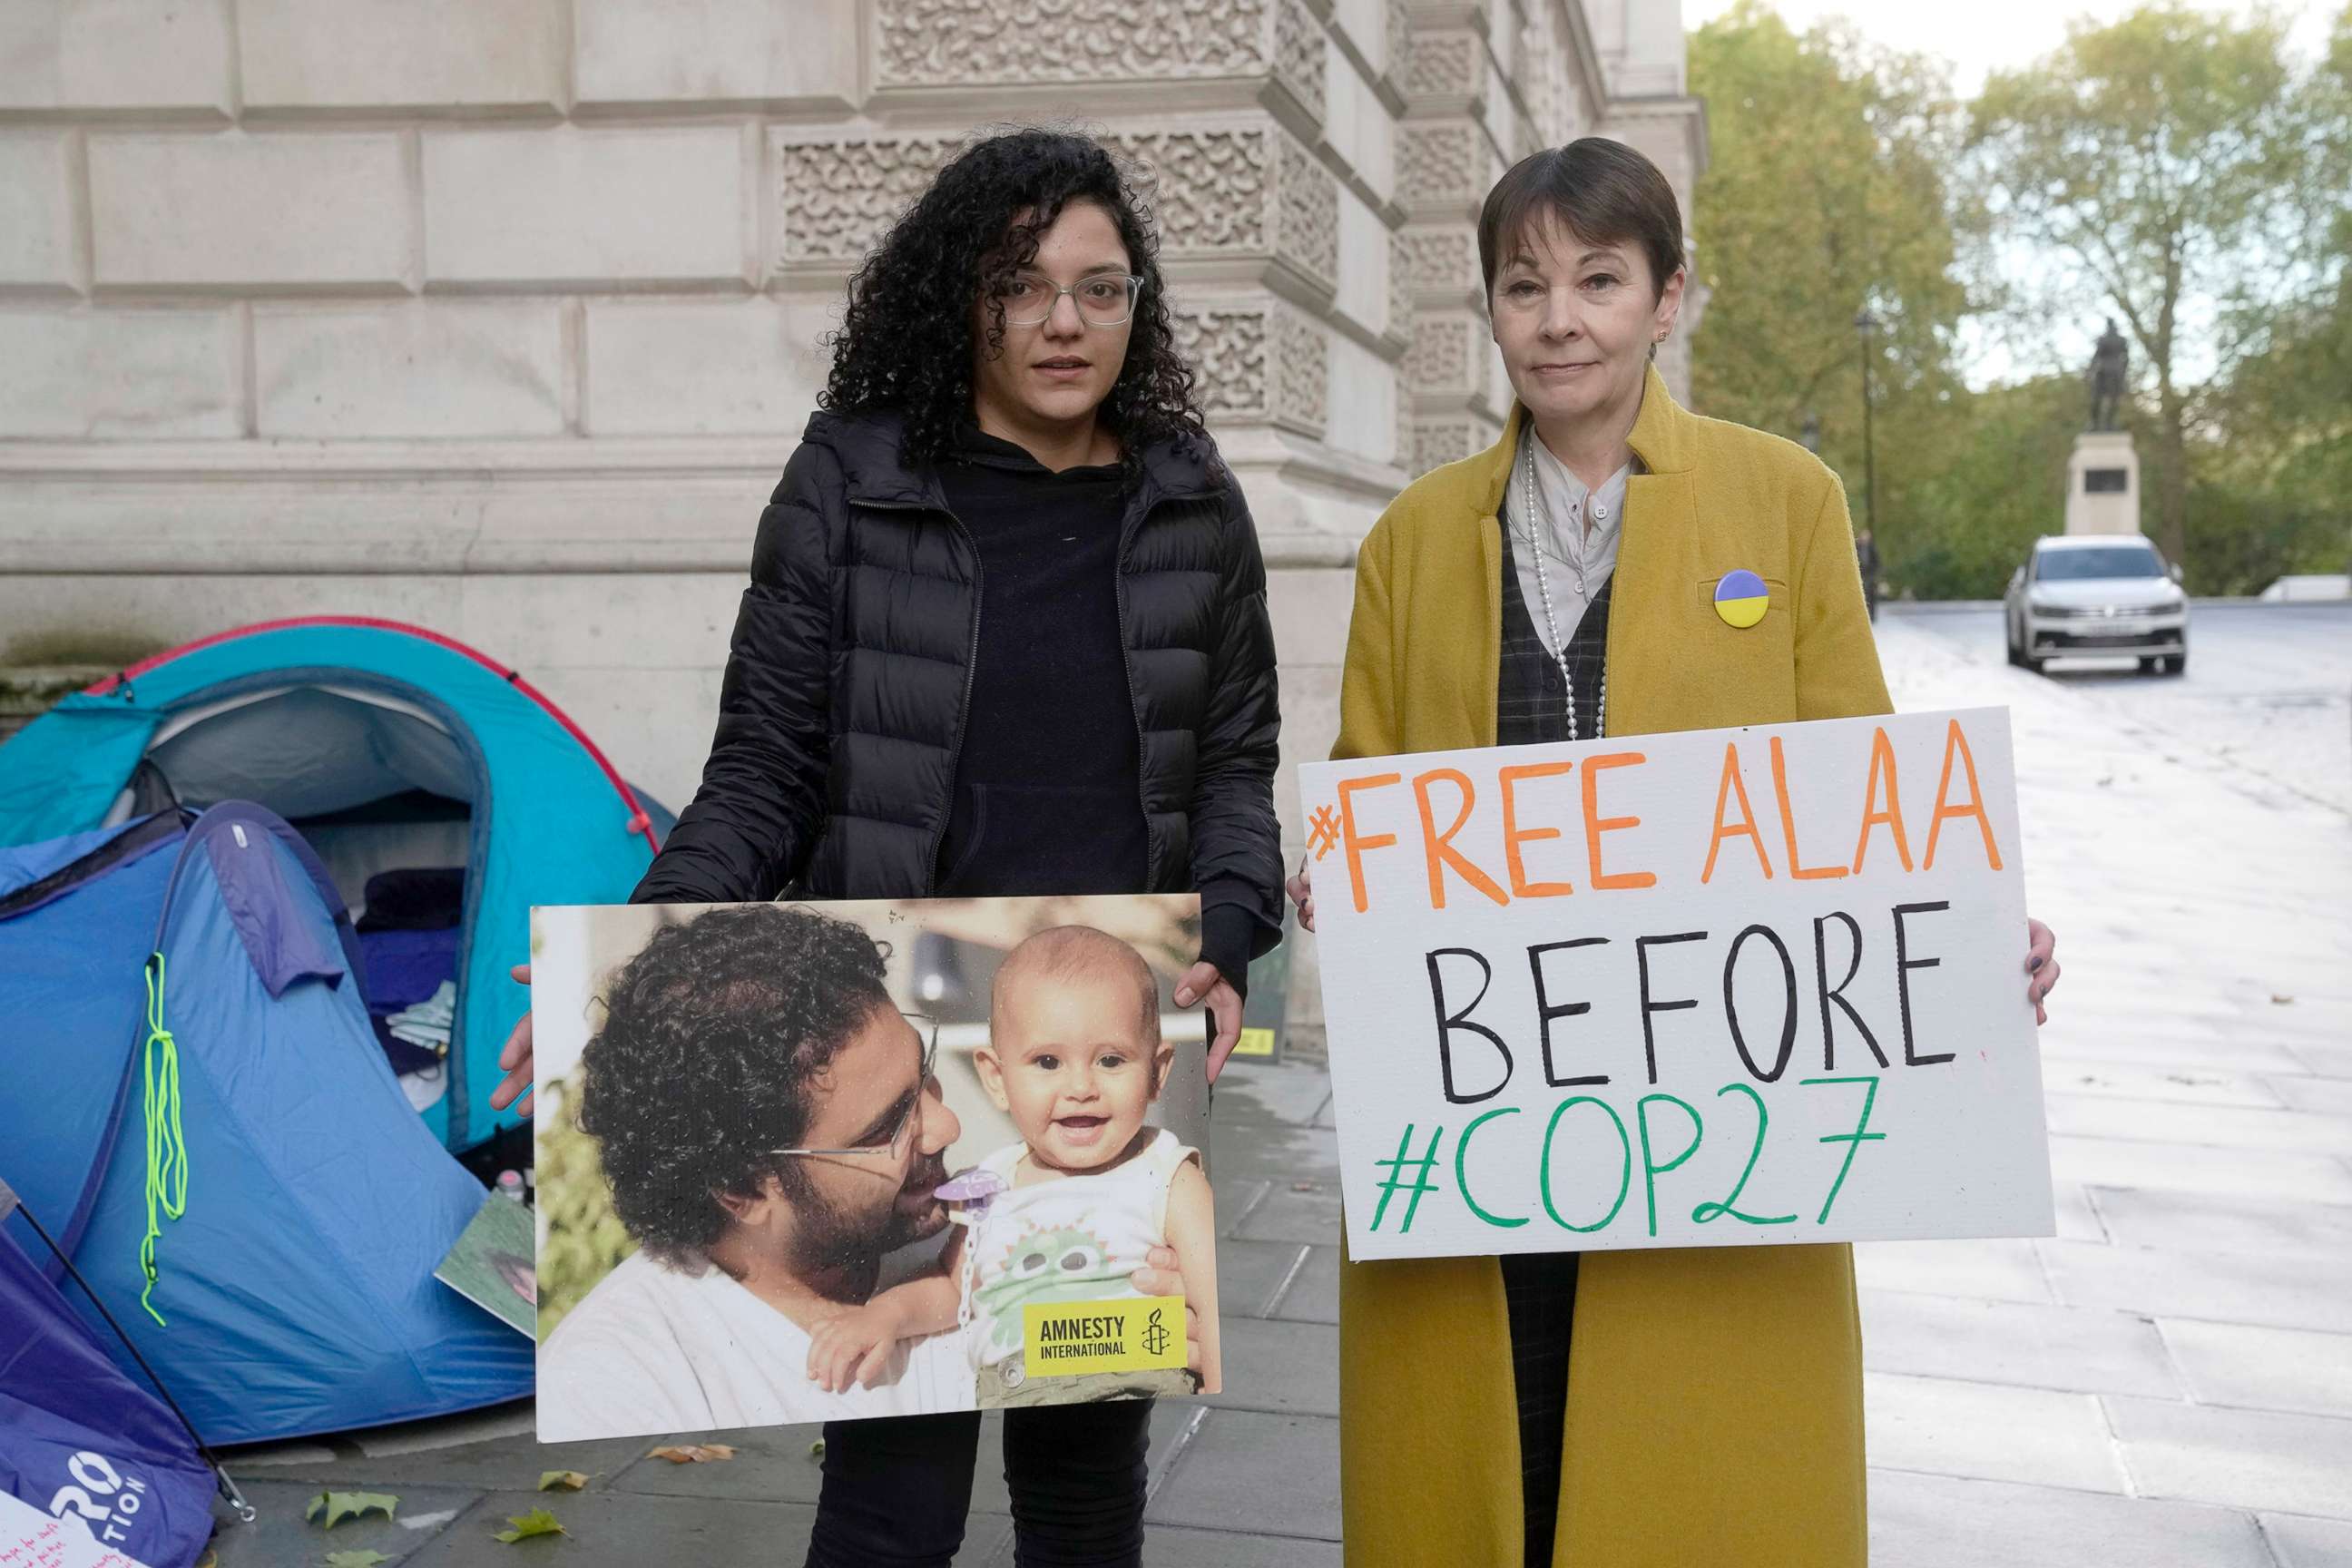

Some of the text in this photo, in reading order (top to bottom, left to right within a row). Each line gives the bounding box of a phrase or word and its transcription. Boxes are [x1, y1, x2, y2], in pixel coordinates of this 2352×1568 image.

[1307, 719, 2004, 913] #FREE ALAA
[1425, 900, 1957, 1105] BEFORE
[1369, 1075, 1888, 1238] #COP27
[1040, 1316, 1125, 1342] AMNESTY
[1040, 1341, 1126, 1360] INTERNATIONAL
